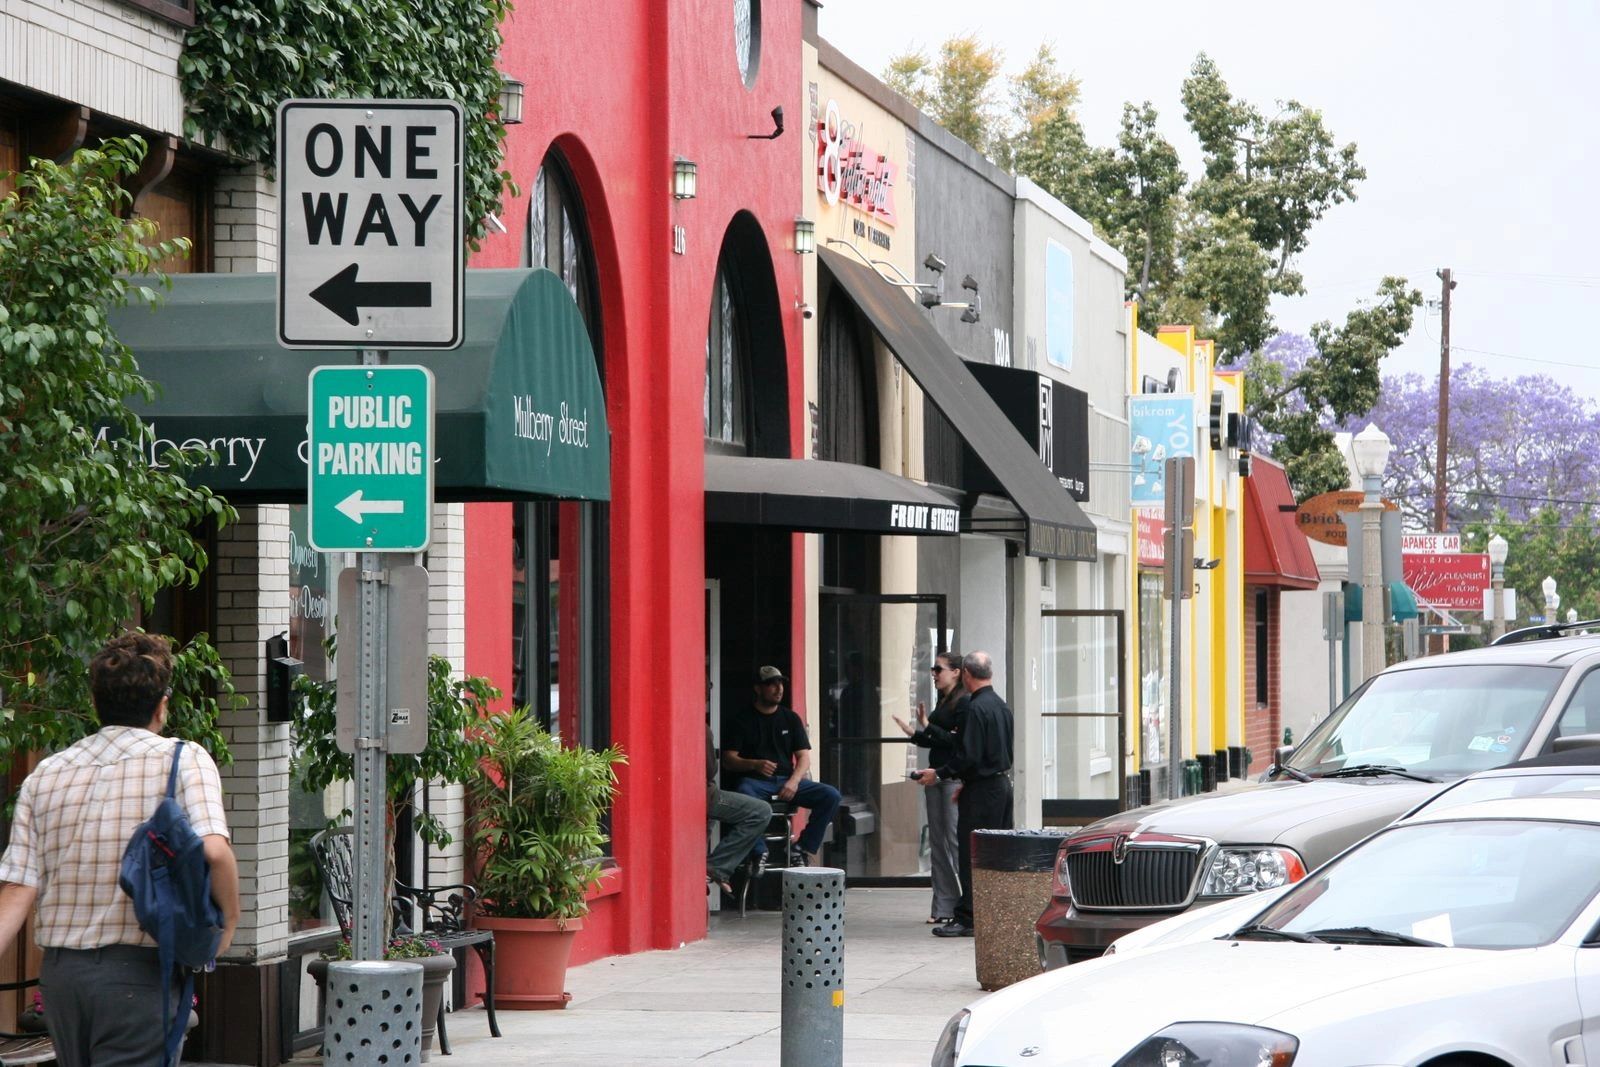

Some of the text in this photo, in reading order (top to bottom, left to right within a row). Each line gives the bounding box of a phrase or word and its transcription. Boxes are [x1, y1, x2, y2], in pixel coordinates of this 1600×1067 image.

[304, 123, 438, 180] ONE
[302, 193, 442, 247] WAY
[328, 395, 412, 430] PUBLIC
[513, 394, 589, 457] Mulberry Street
[1133, 405, 1175, 417] bikram
[318, 441, 422, 476] PARKING
[890, 503, 929, 530] FRONT
[931, 507, 956, 532] STREET
[289, 530, 319, 578] Dynasty
[1442, 536, 1459, 550] CAR
